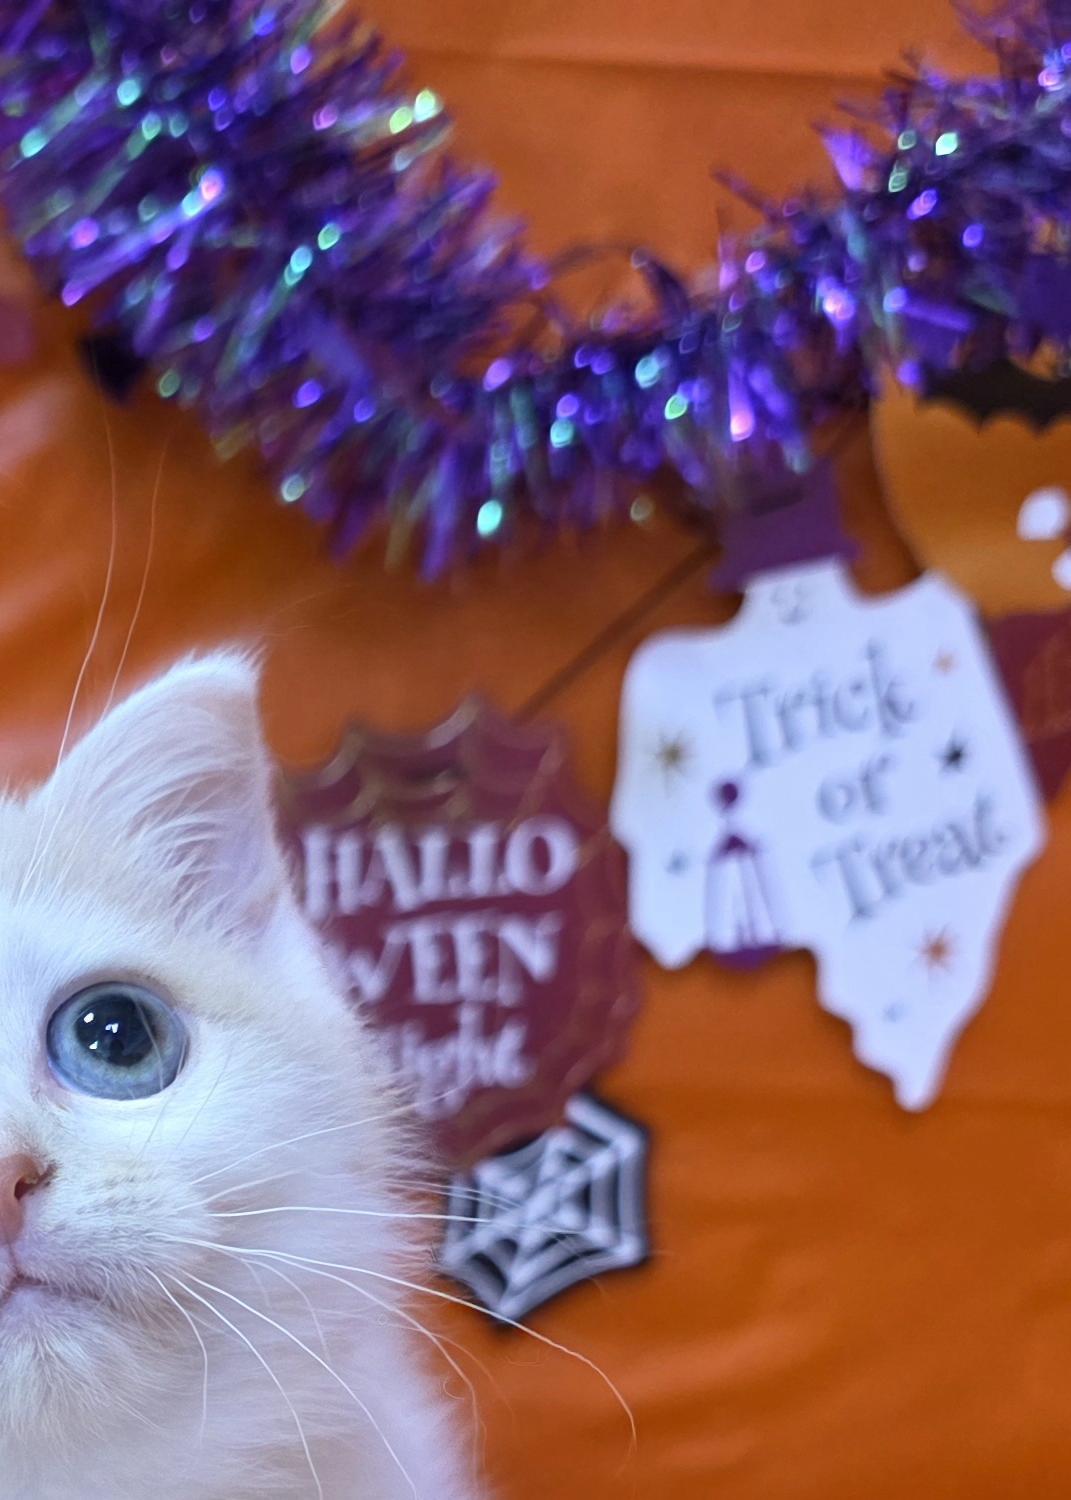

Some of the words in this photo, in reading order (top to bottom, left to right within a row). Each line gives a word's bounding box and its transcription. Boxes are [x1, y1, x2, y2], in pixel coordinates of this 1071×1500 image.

[713, 638, 917, 768] Trick
[815, 752, 896, 824] or
[301, 813, 579, 923] HALLO
[810, 793, 1007, 924] Treat
